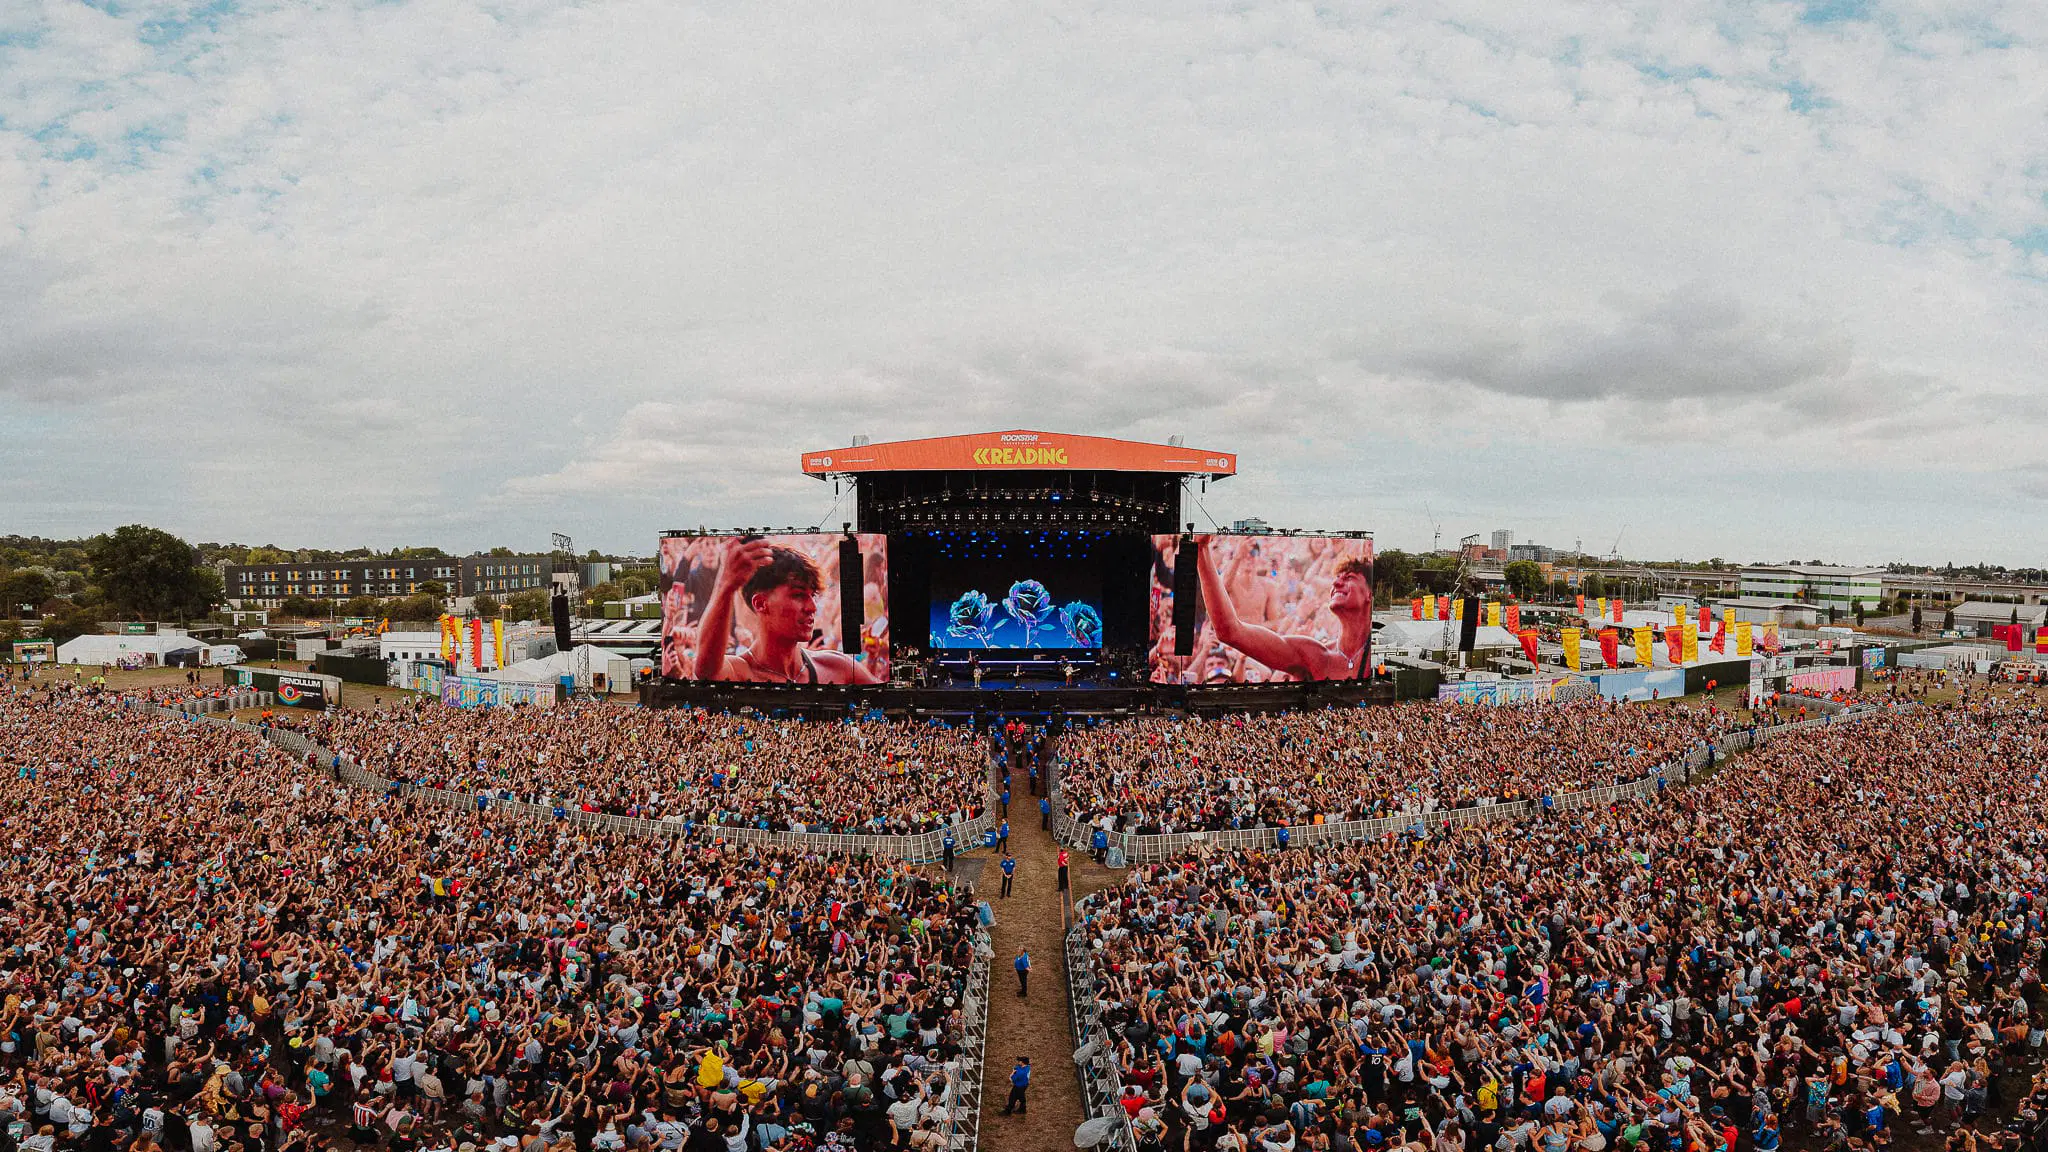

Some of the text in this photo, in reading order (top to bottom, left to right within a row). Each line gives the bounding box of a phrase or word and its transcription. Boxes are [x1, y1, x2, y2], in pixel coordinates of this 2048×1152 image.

[1001, 434, 1039, 442] ROCKSTAR
[990, 447, 1068, 465] READING
[279, 676, 321, 688] PENDULUM
[1371, 1056, 1381, 1065] 10
[144, 1117, 155, 1129] 10
